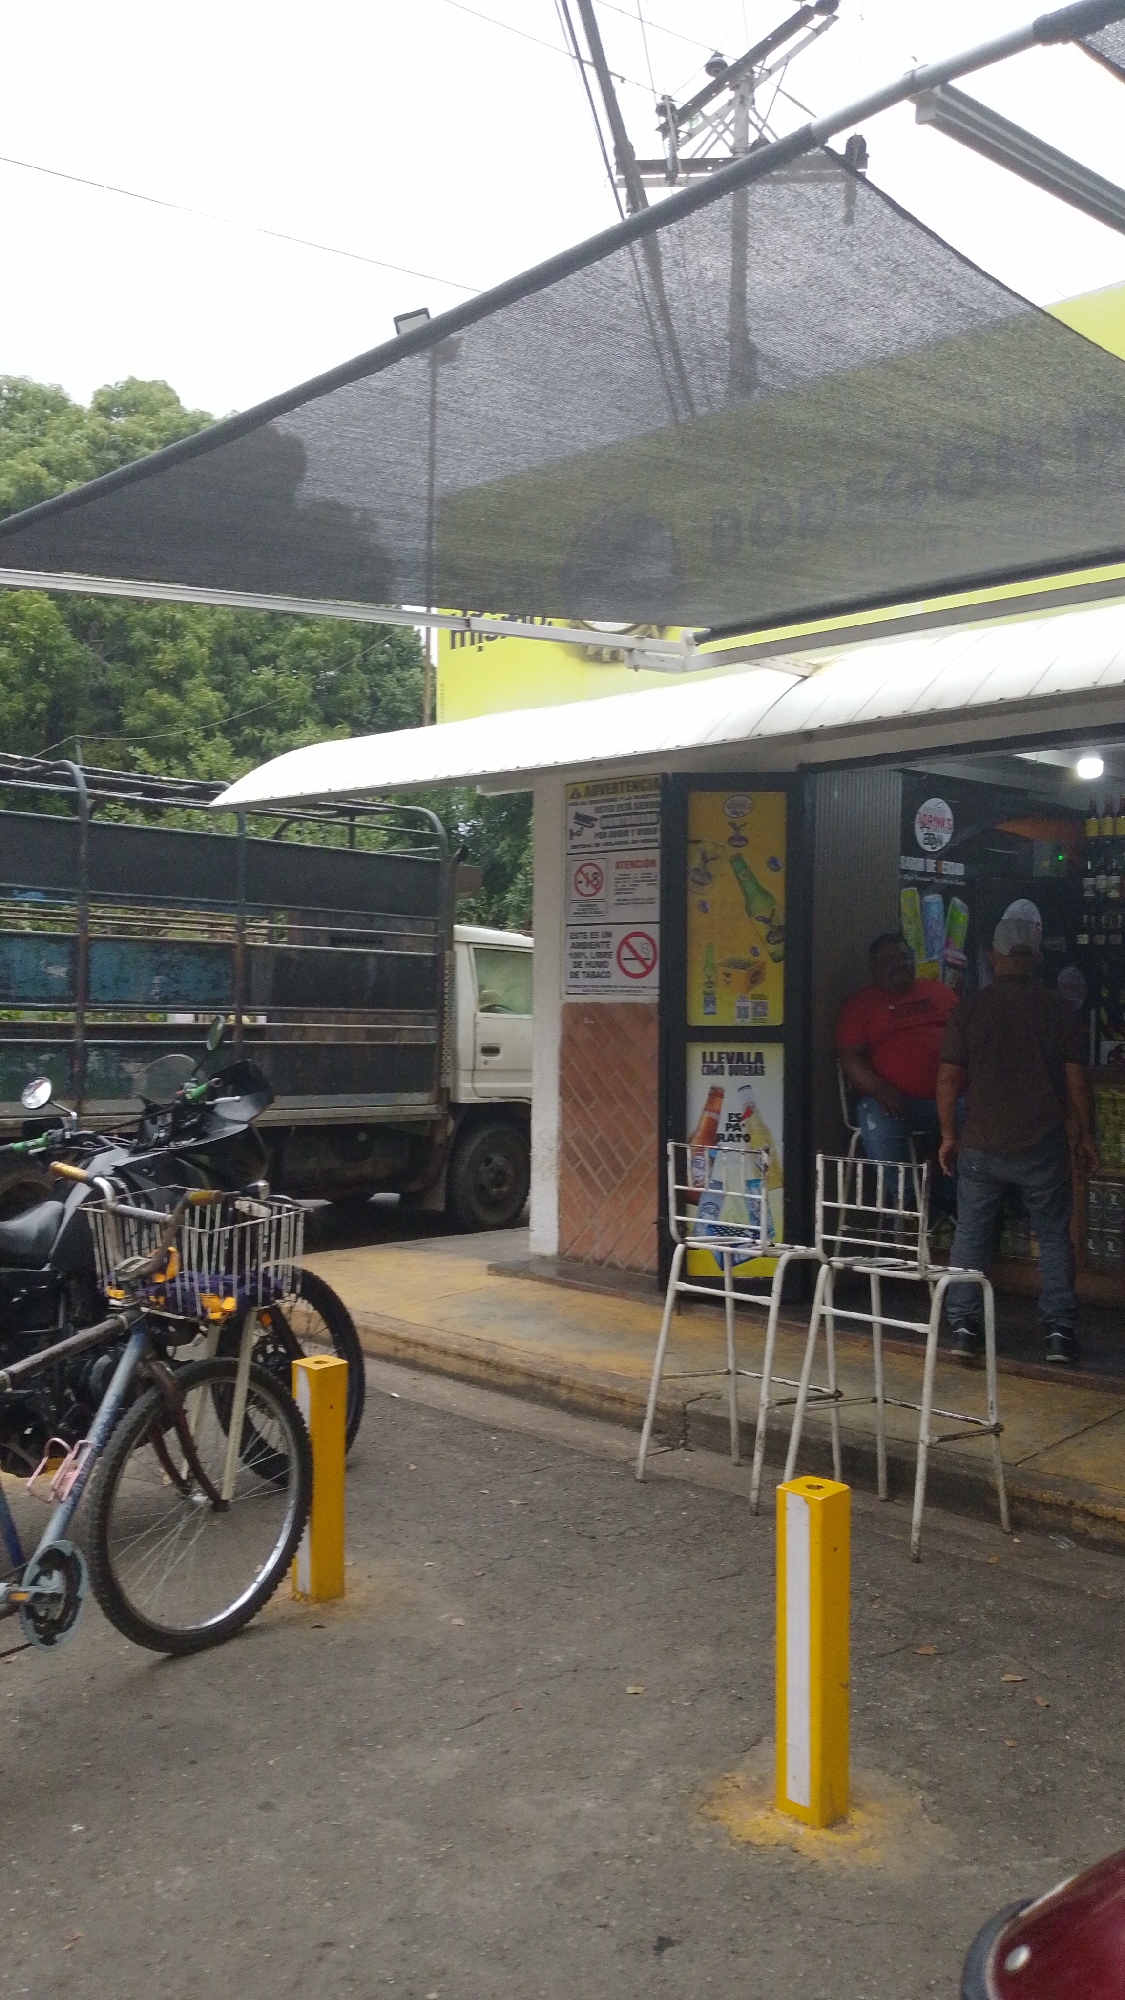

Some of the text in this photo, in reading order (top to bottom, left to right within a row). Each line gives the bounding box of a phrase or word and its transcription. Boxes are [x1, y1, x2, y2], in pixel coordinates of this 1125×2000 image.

[585, 777, 660, 797] ADVERTENCIA
[570, 941, 611, 949] AMBIENTE
[702, 1051, 764, 1064] LLEVALA
[702, 1065, 765, 1076] COMO QUIERAS
[728, 1113, 742, 1122] ES
[717, 1133, 751, 1142] RATO
